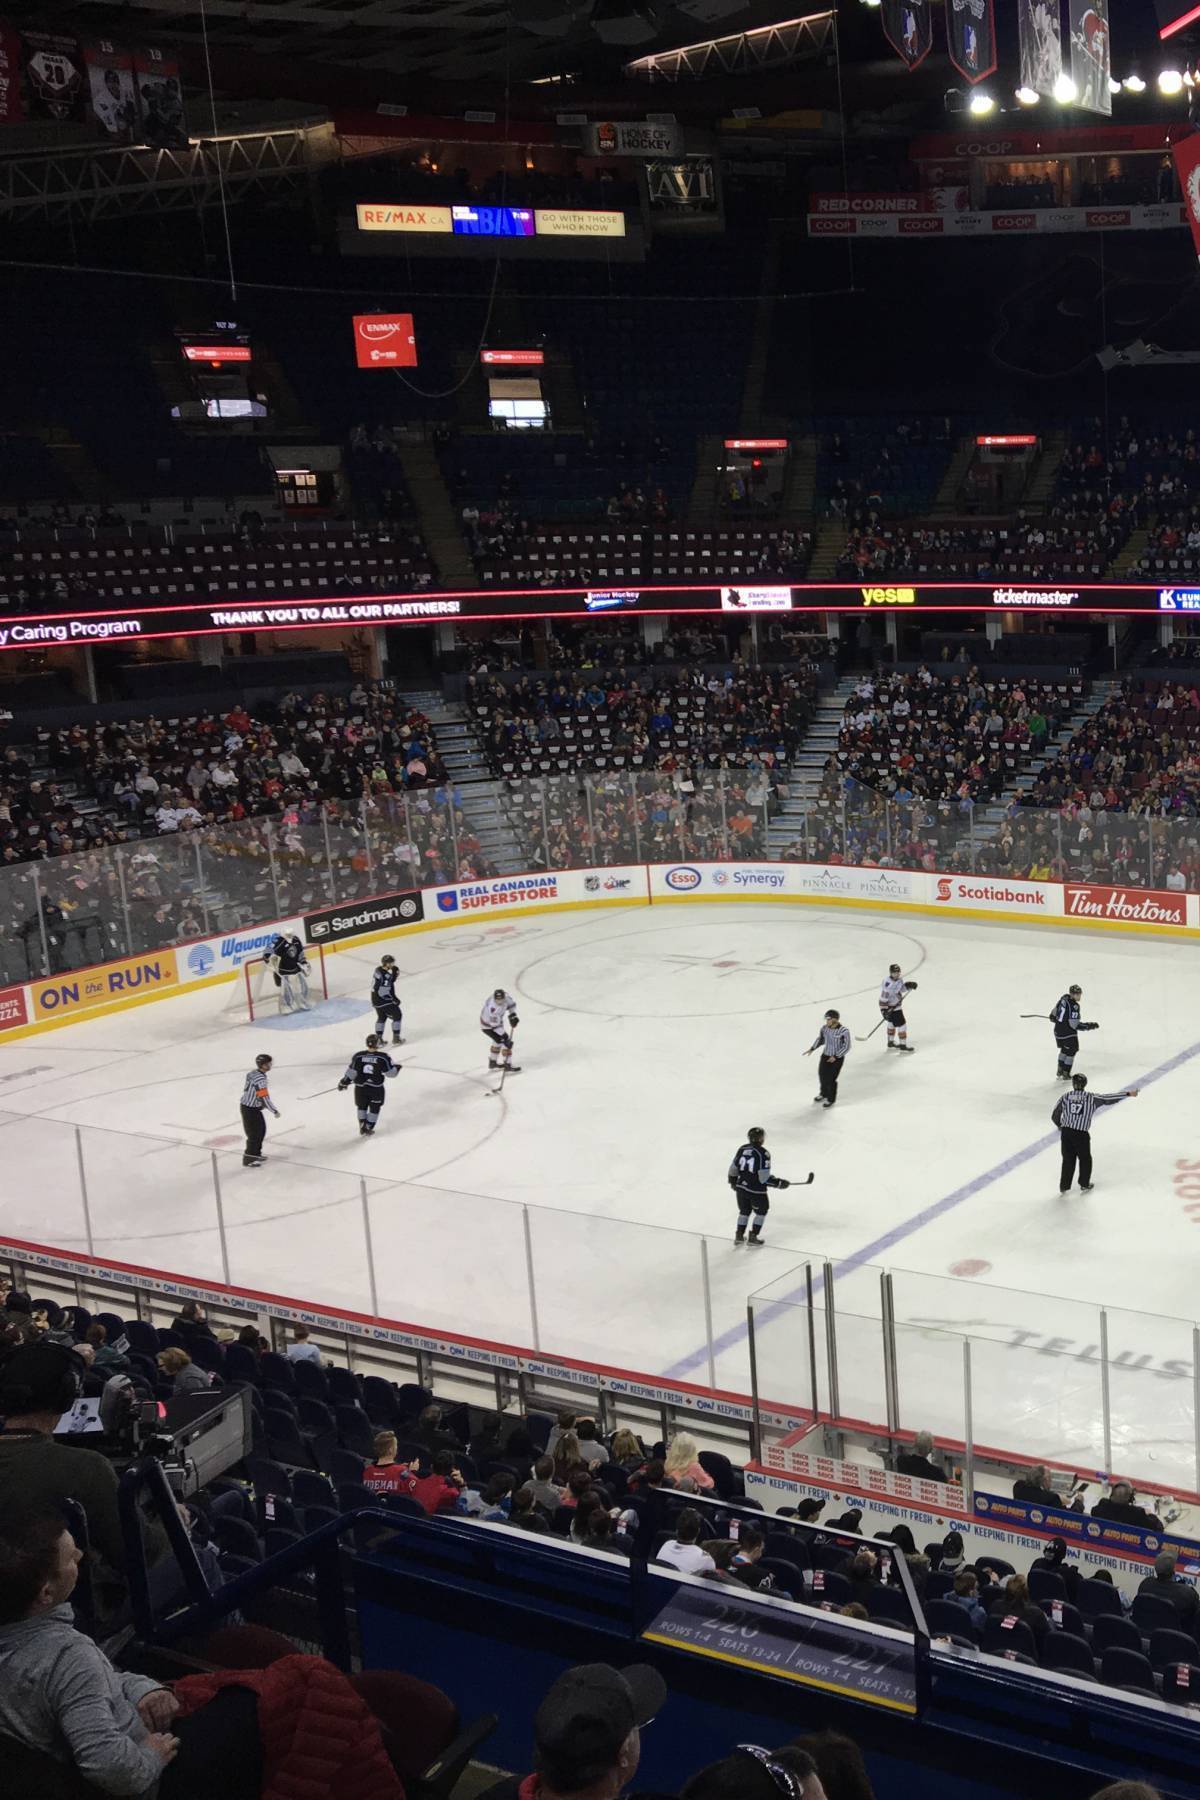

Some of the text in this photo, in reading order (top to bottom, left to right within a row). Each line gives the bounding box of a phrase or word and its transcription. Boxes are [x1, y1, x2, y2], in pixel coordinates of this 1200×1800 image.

[621, 138, 671, 150] HOCKEY
[818, 198, 918, 212] RED CORNER
[364, 210, 426, 224] RE/MAX
[541, 213, 555, 223] GO
[559, 213, 584, 223] WITH
[587, 215, 618, 224] THOSE
[552, 223, 609, 232] WHO KNOW
[366, 321, 401, 332] ENMAX
[584, 590, 640, 604] Junior Hockey
[993, 588, 1076, 605] ticketmaster
[211, 600, 461, 626] THANK YOU TO ALL OUR PARTNERS!
[13, 618, 141, 645] Caring Program
[460, 876, 557, 899] REAL CANADIAN
[671, 872, 696, 884] Esso
[734, 872, 785, 887] Synergy
[802, 878, 852, 890] PINNACLE
[860, 882, 910, 895] PINNACLE
[958, 884, 1046, 905] Scotiabank
[461, 887, 558, 910] SUPERSTORE
[1068, 890, 1183, 924] Tim Hortons
[332, 906, 399, 931] Sandman
[221, 932, 279, 959] Wawane
[40, 960, 162, 1009] ON the RUN
[1070, 1103, 1082, 1115] 87
[1006, 1329, 1197, 1380] TELUS
[808, 1487, 830, 1502] FRESH
[869, 1499, 934, 1526] KEEPING IT FRESH
[974, 1525, 1041, 1551] KEEPING IT FRESH
[660, 1621, 693, 1641] ROWS
[718, 1637, 749, 1654] SEATS
[796, 1658, 830, 1676] ROWS
[858, 1675, 890, 1693] SEATS
